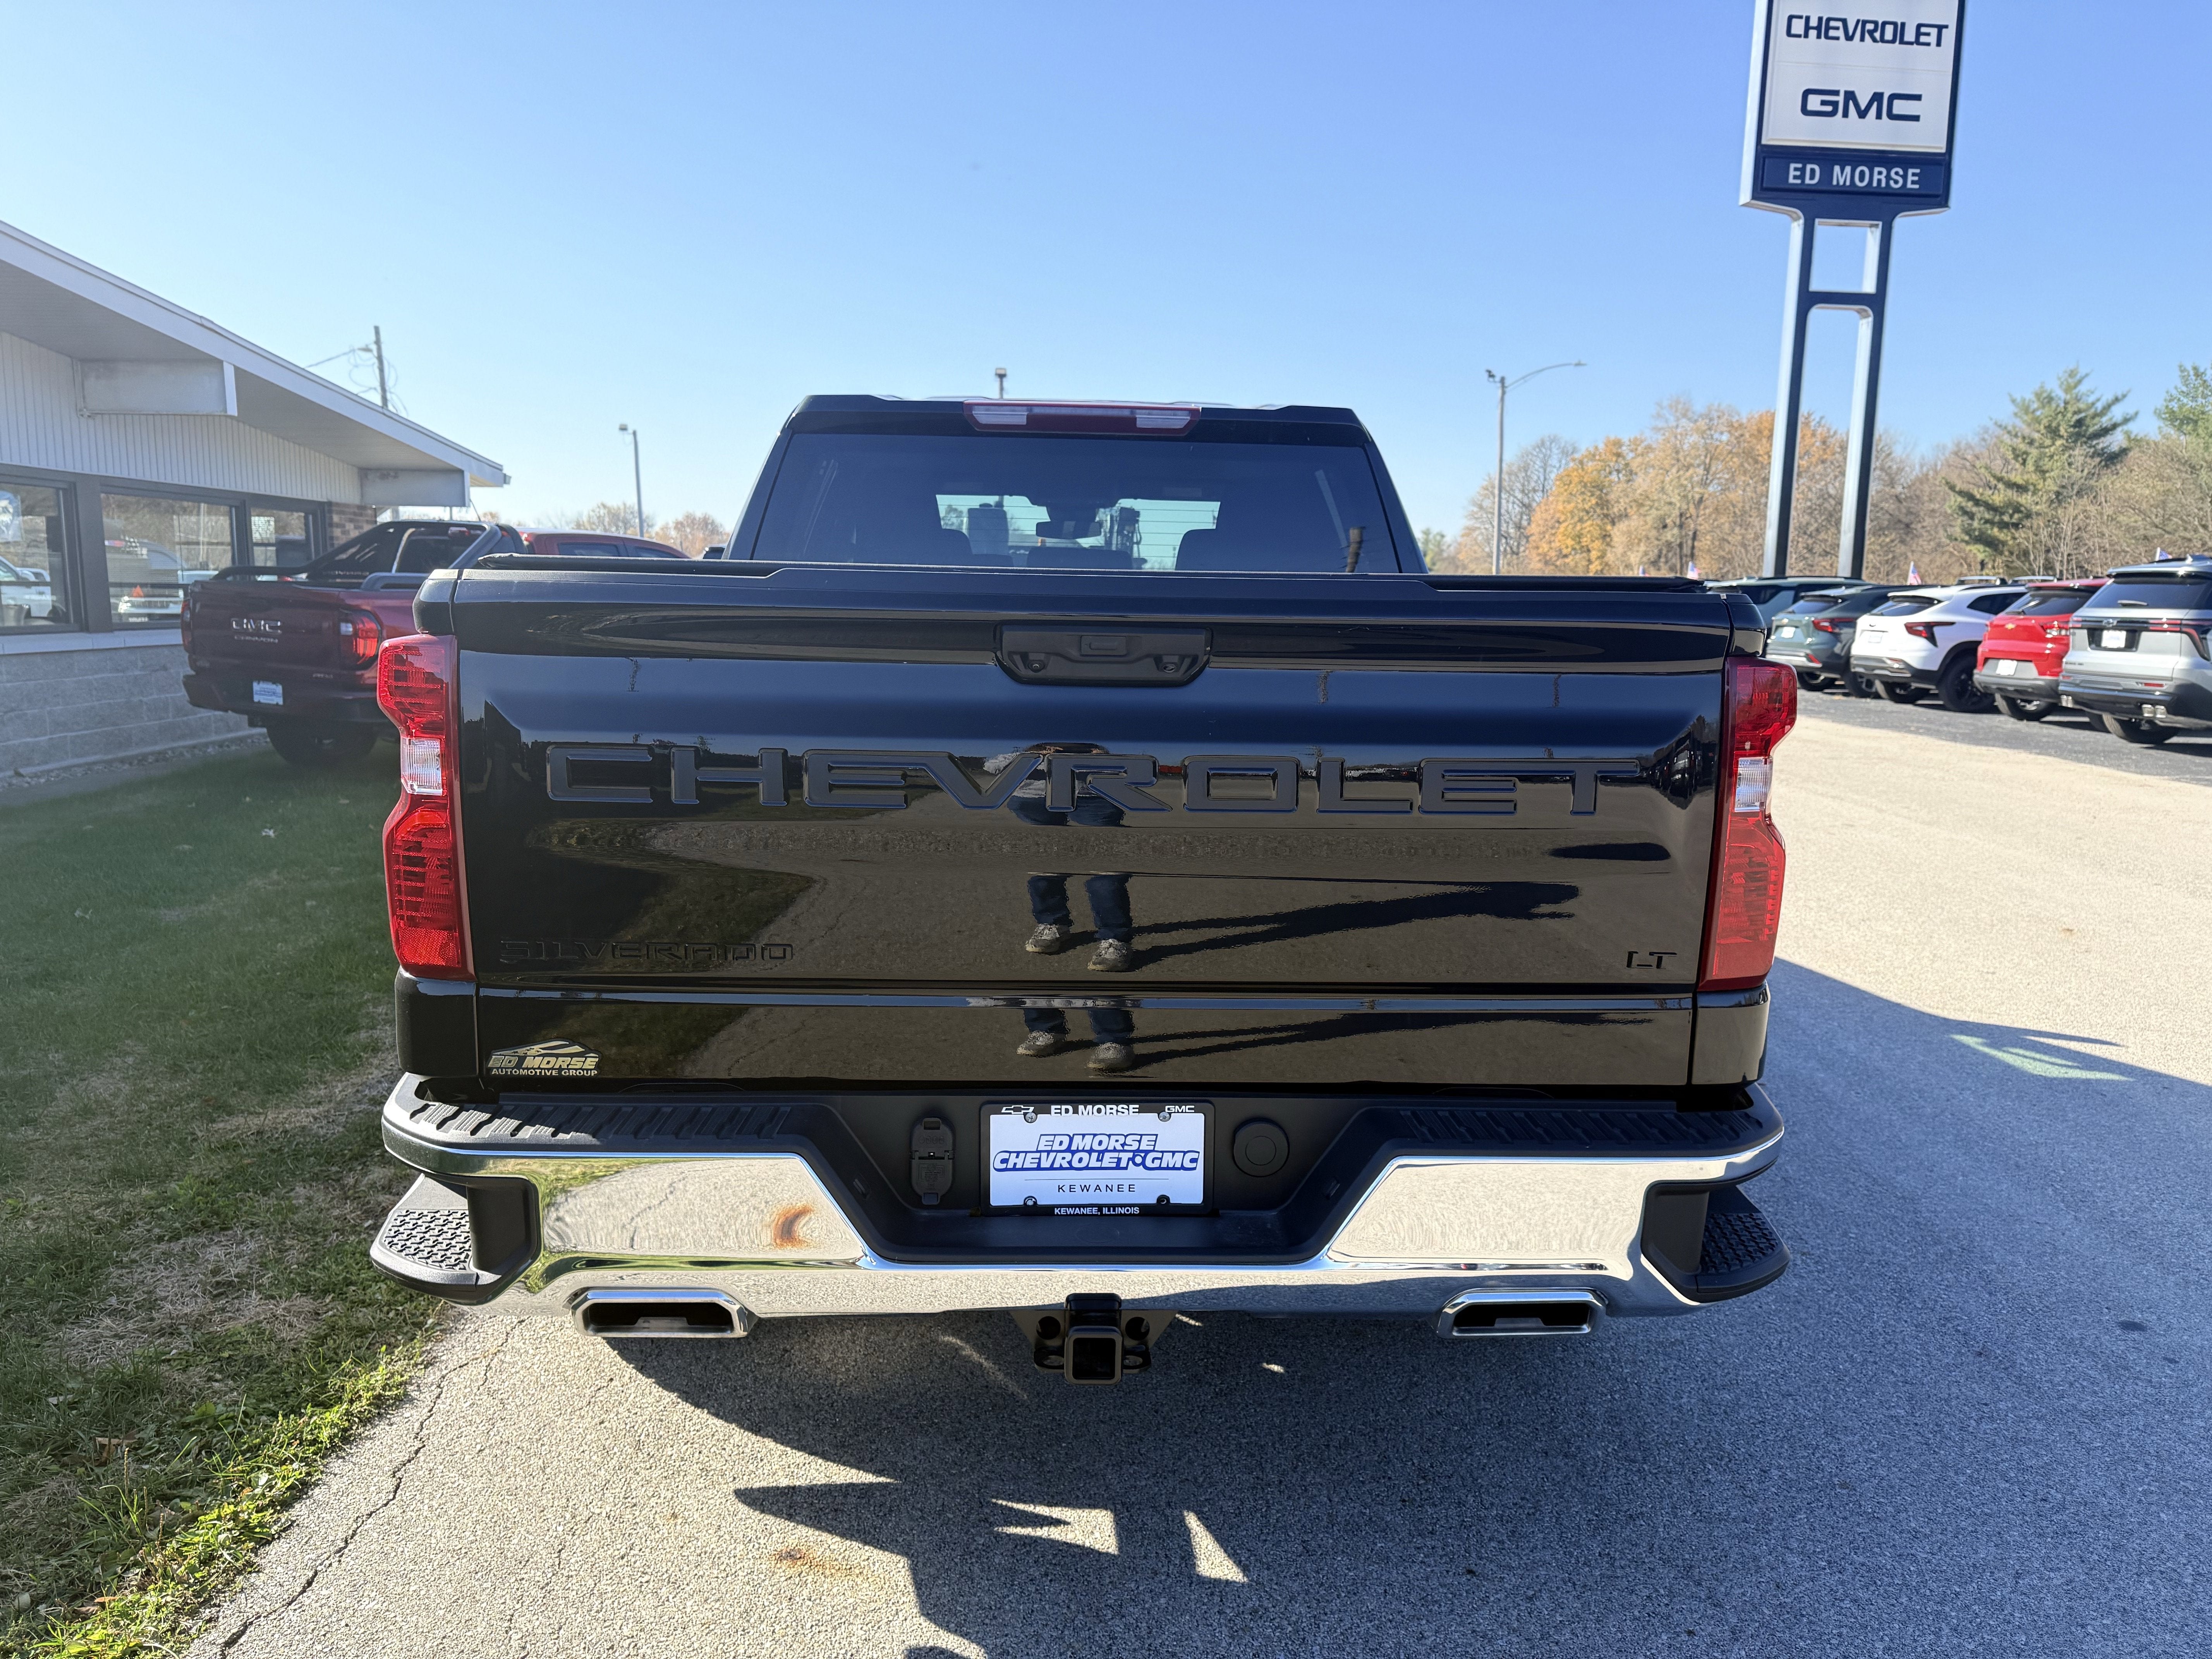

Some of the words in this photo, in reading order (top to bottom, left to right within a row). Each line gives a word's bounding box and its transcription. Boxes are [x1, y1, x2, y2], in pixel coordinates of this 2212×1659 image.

[1786, 14, 1949, 47] CHEVROLET
[1800, 88, 1922, 122] GMC
[1788, 163, 1820, 184] ED
[1832, 165, 1920, 189] MORSE
[546, 744, 1640, 815] CHEVROLET
[500, 940, 794, 962] SILVERADO
[1626, 951, 1677, 969] LT
[488, 1056, 519, 1067] ED
[522, 1056, 599, 1069] MORSE
[1051, 1105, 1073, 1116] ED
[1078, 1104, 1139, 1116] MORSE
[1037, 1135, 1070, 1150] ED
[1071, 1134, 1157, 1150] MORSE
[1058, 1184, 1136, 1193] KEWANEE
